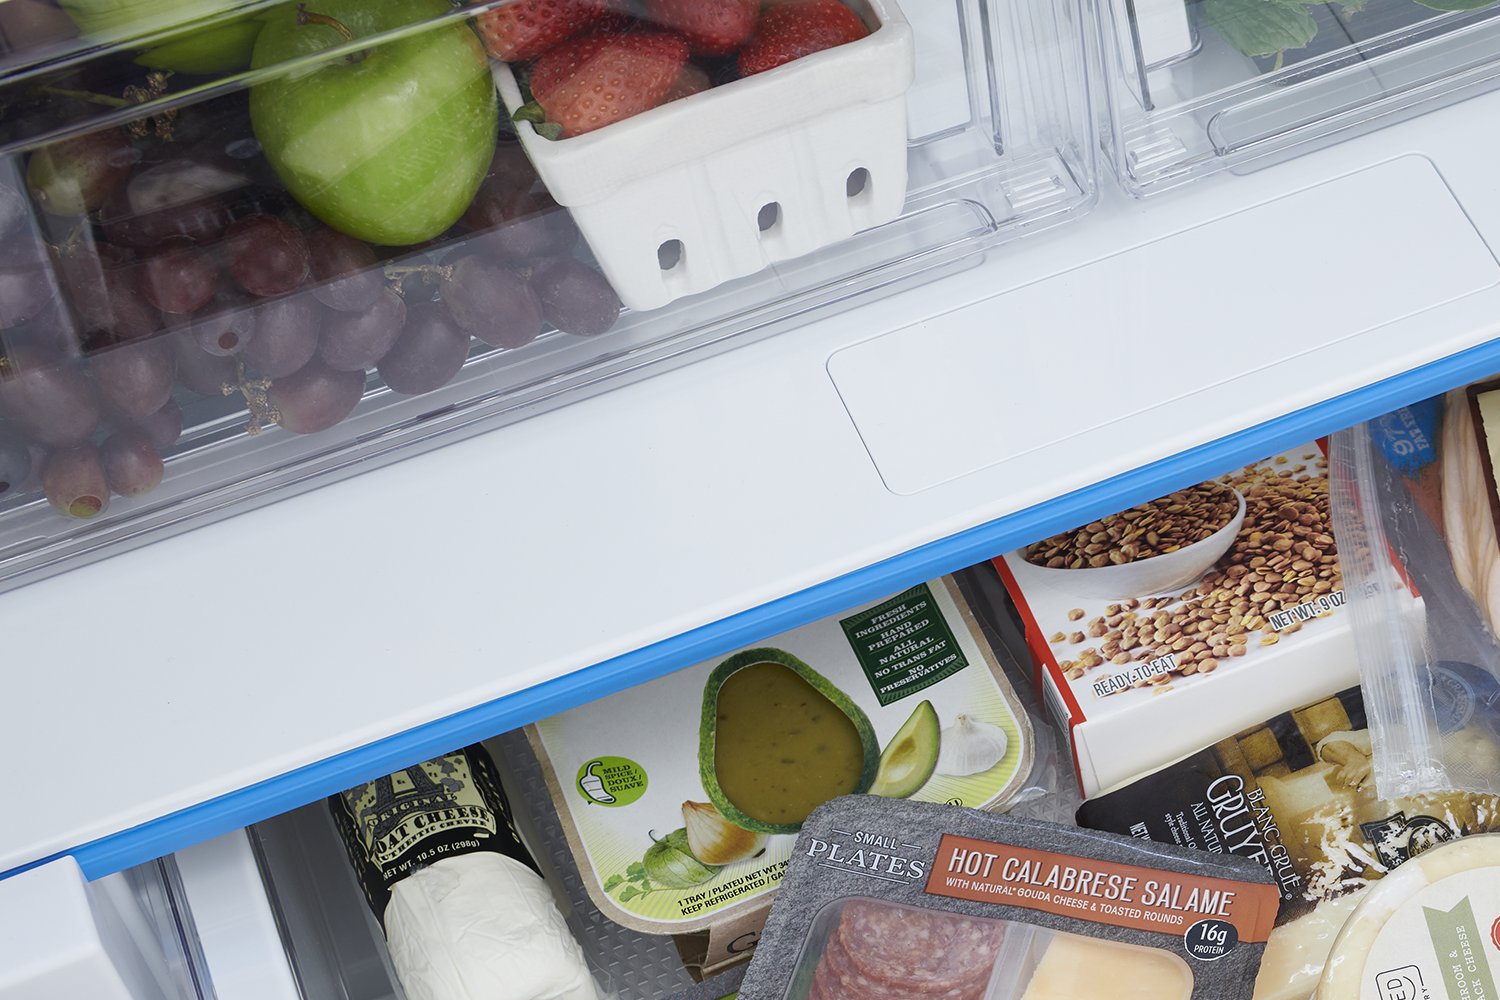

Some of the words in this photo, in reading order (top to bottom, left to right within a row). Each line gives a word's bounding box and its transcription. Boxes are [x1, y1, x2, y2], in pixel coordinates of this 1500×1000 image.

[855, 601, 927, 638] INGREDIENTS
[871, 604, 906, 624] FRESH
[1269, 608, 1295, 631] NET
[1293, 602, 1320, 622] WT.
[1319, 599, 1330, 613] 9
[1328, 591, 1347, 609] OZ
[868, 619, 929, 651] PREPARED
[880, 622, 912, 639] HAND
[894, 639, 916, 652] ALL
[875, 668, 890, 678] NO
[892, 652, 927, 671] TRANS
[928, 640, 946, 654] FAT
[879, 636, 934, 664] NATURAL
[880, 654, 956, 694] PRESERVATIVES
[909, 664, 924, 676] NO
[603, 764, 630, 774] MILD
[605, 771, 633, 780] SPICE
[608, 776, 636, 786] DOUX
[610, 781, 643, 792] SUAVE
[414, 806, 490, 829] CHEESE
[1247, 788, 1280, 842] BLANC
[854, 831, 897, 850] SMALL
[383, 866, 397, 880] NET
[399, 858, 415, 871] WT.
[417, 850, 435, 862] 10.5
[437, 843, 450, 853] OZ
[452, 839, 480, 851] (298g)
[806, 837, 926, 880] PLATES
[681, 902, 703, 916] KEEP
[705, 878, 765, 907] REFRIGERATED
[684, 893, 706, 905] TRAY
[712, 878, 744, 895] PLATEU
[745, 871, 762, 882] NET
[762, 864, 778, 876] WT
[948, 847, 998, 876] HOT
[1001, 855, 1133, 903] CALABRESE
[1140, 878, 1236, 917] SALAME
[945, 878, 969, 891] WITH
[1017, 887, 1051, 902] GOUDA
[1052, 892, 1089, 909] CHEESE
[1099, 904, 1142, 920] TOASTED
[1144, 910, 1184, 926] ROUNDS
[1198, 922, 1228, 946] 16g
[1456, 925, 1476, 973] CHEESE
[1194, 944, 1225, 956] PROTEIN
